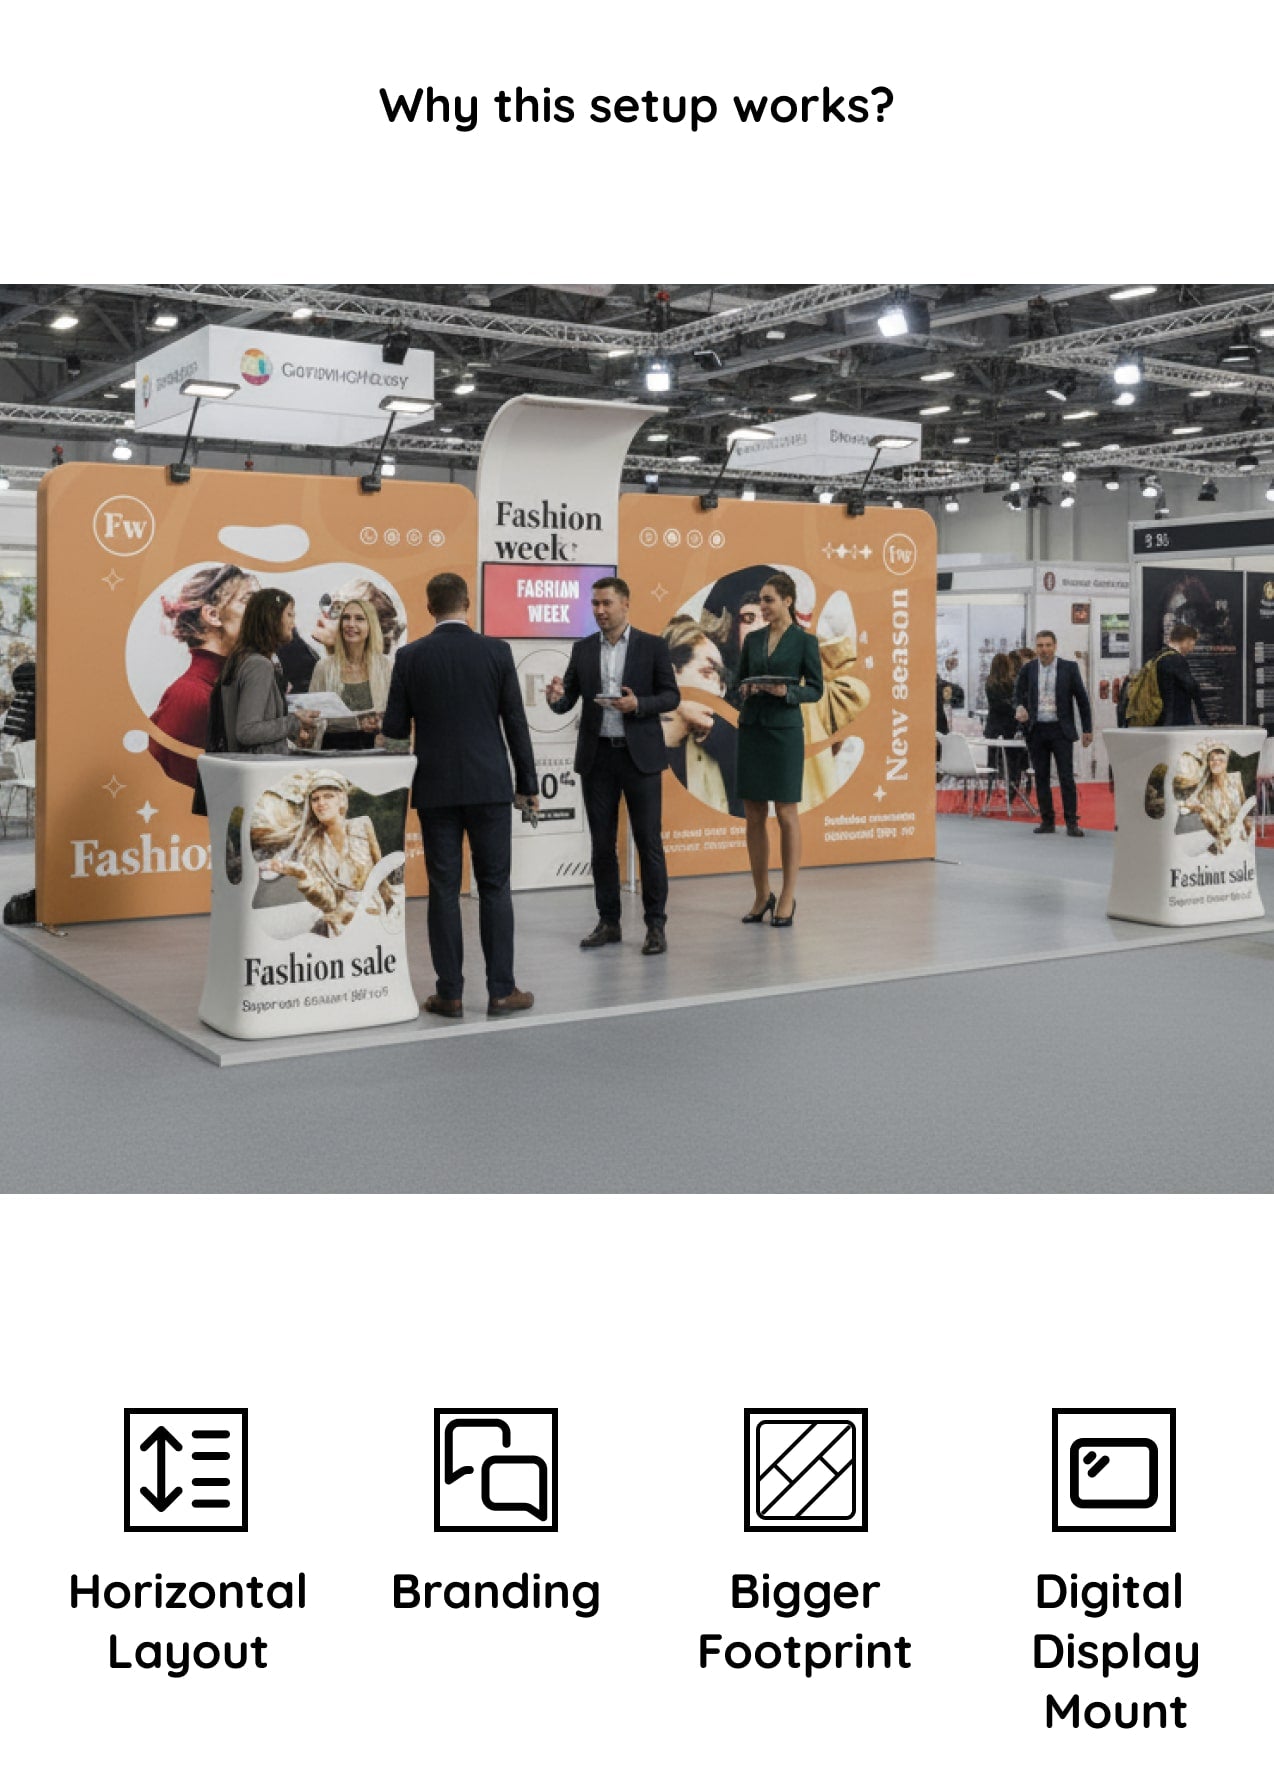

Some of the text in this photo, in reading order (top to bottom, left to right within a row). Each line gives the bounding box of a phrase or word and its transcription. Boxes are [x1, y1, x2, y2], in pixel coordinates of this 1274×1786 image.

[104, 512, 148, 540] Fw
[495, 499, 602, 531] Fashion
[527, 603, 570, 623] WEEK
[886, 709, 909, 782] New
[70, 833, 212, 878] Fashio
[244, 944, 397, 987] Fashion sale
